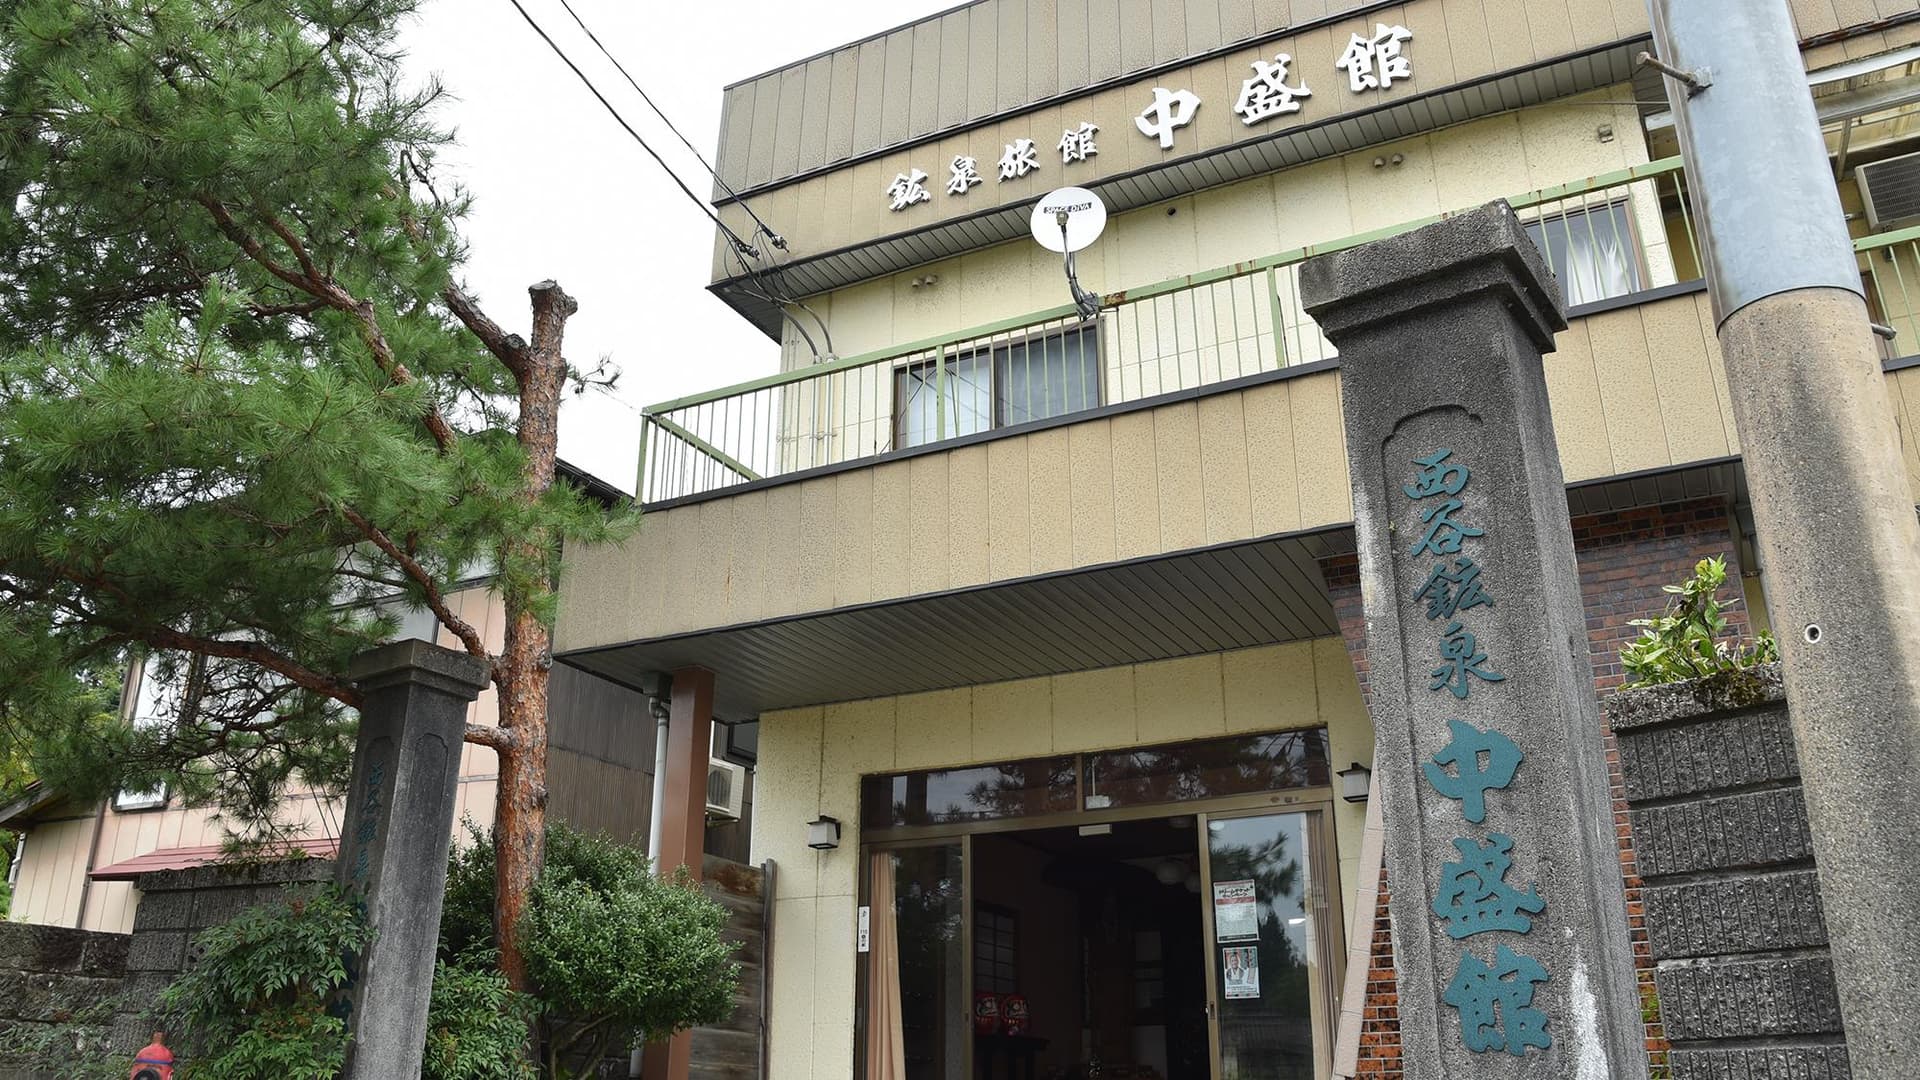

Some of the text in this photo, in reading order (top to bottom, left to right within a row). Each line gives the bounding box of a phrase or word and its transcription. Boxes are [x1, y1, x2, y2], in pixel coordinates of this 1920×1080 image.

[1134, 22, 1413, 151] 中盛館
[1422, 719, 1552, 1057] 中盛館
